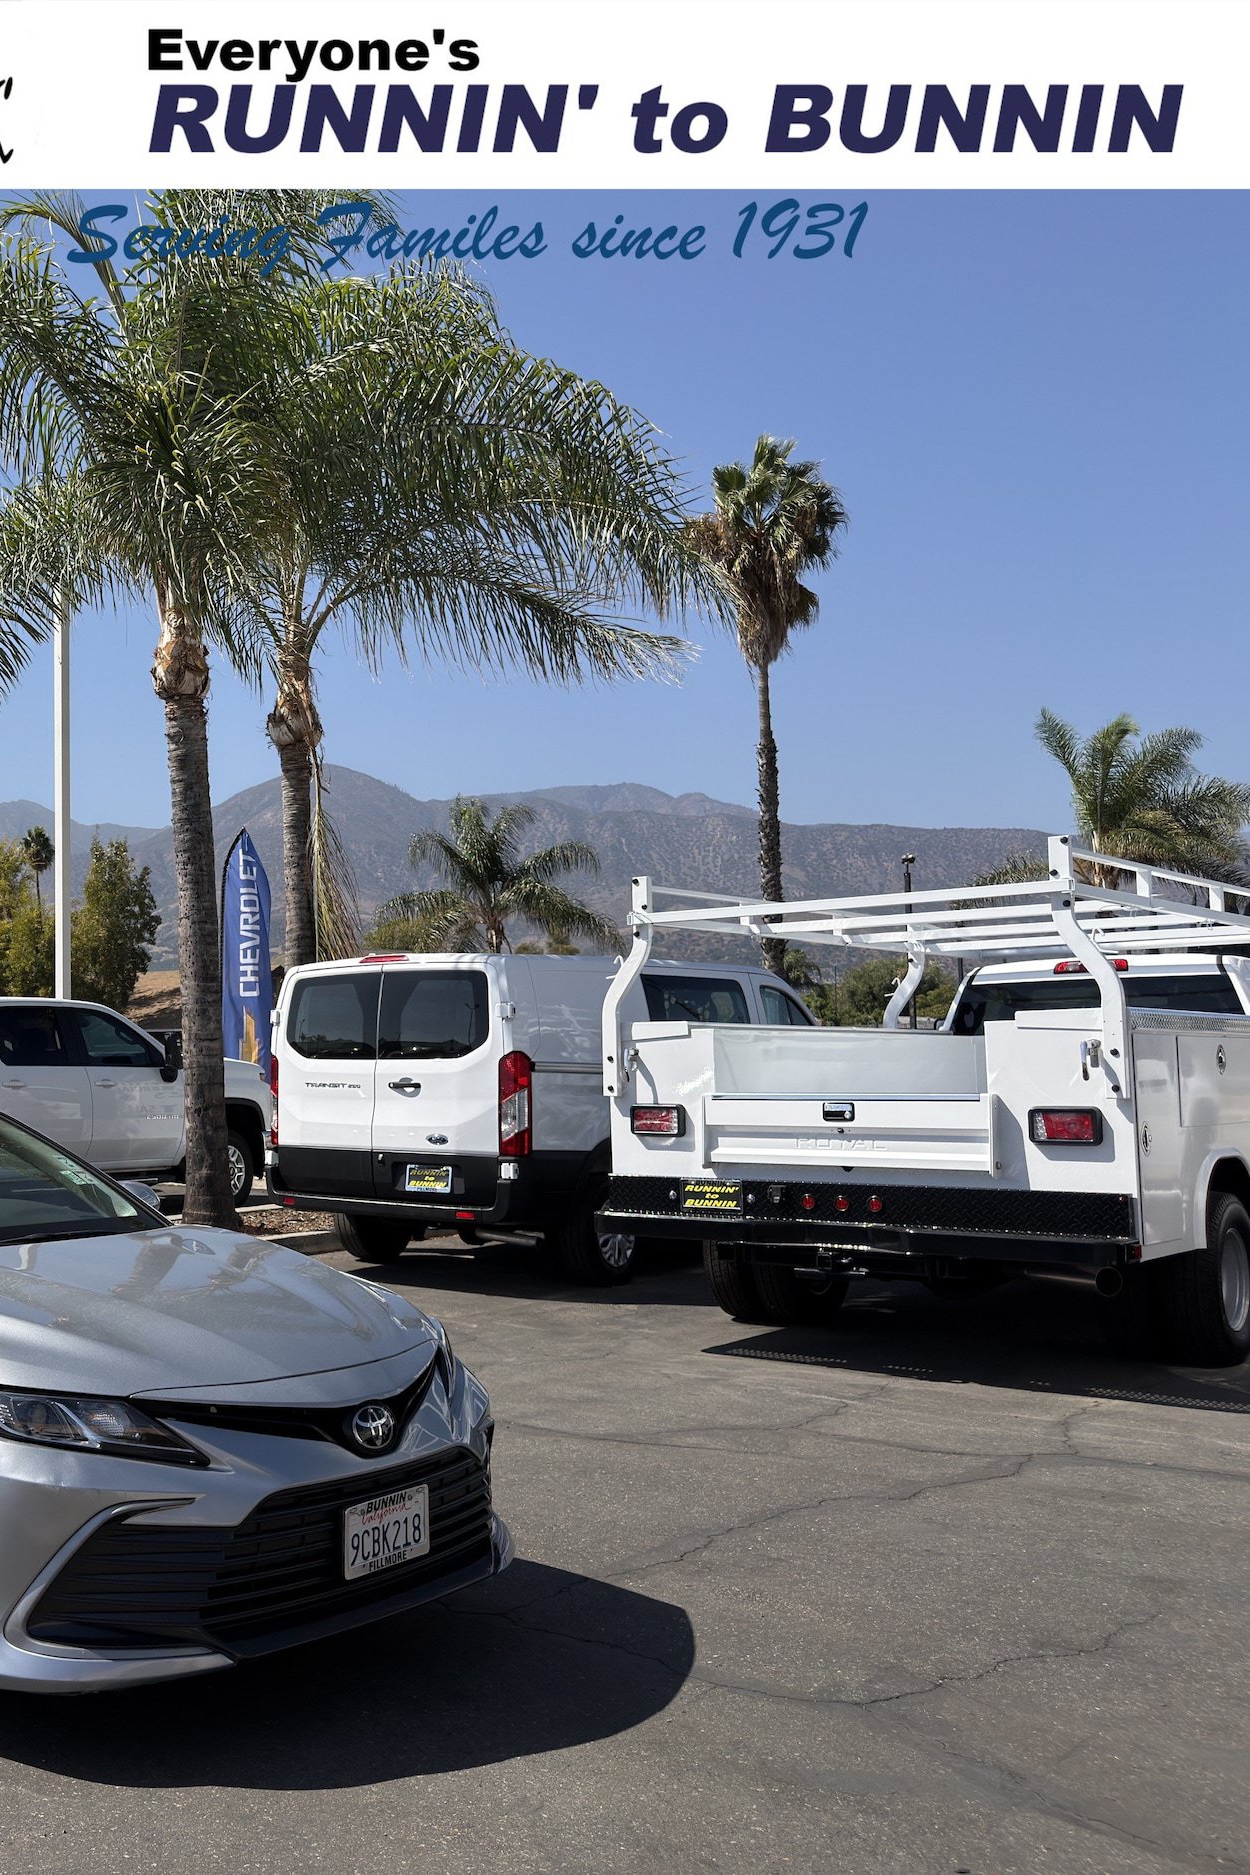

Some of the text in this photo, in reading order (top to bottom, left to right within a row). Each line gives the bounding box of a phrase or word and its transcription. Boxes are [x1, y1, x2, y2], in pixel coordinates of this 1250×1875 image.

[239, 848, 260, 998] CHEVROLET
[796, 1138, 887, 1151] ROYAL
[685, 1185, 739, 1193] RUNNIN'
[685, 1199, 737, 1207] BUNNIN
[366, 1491, 407, 1514] BUNNIN
[350, 1513, 421, 1567] 9CBK218
[369, 1549, 407, 1572] FILLMORE
